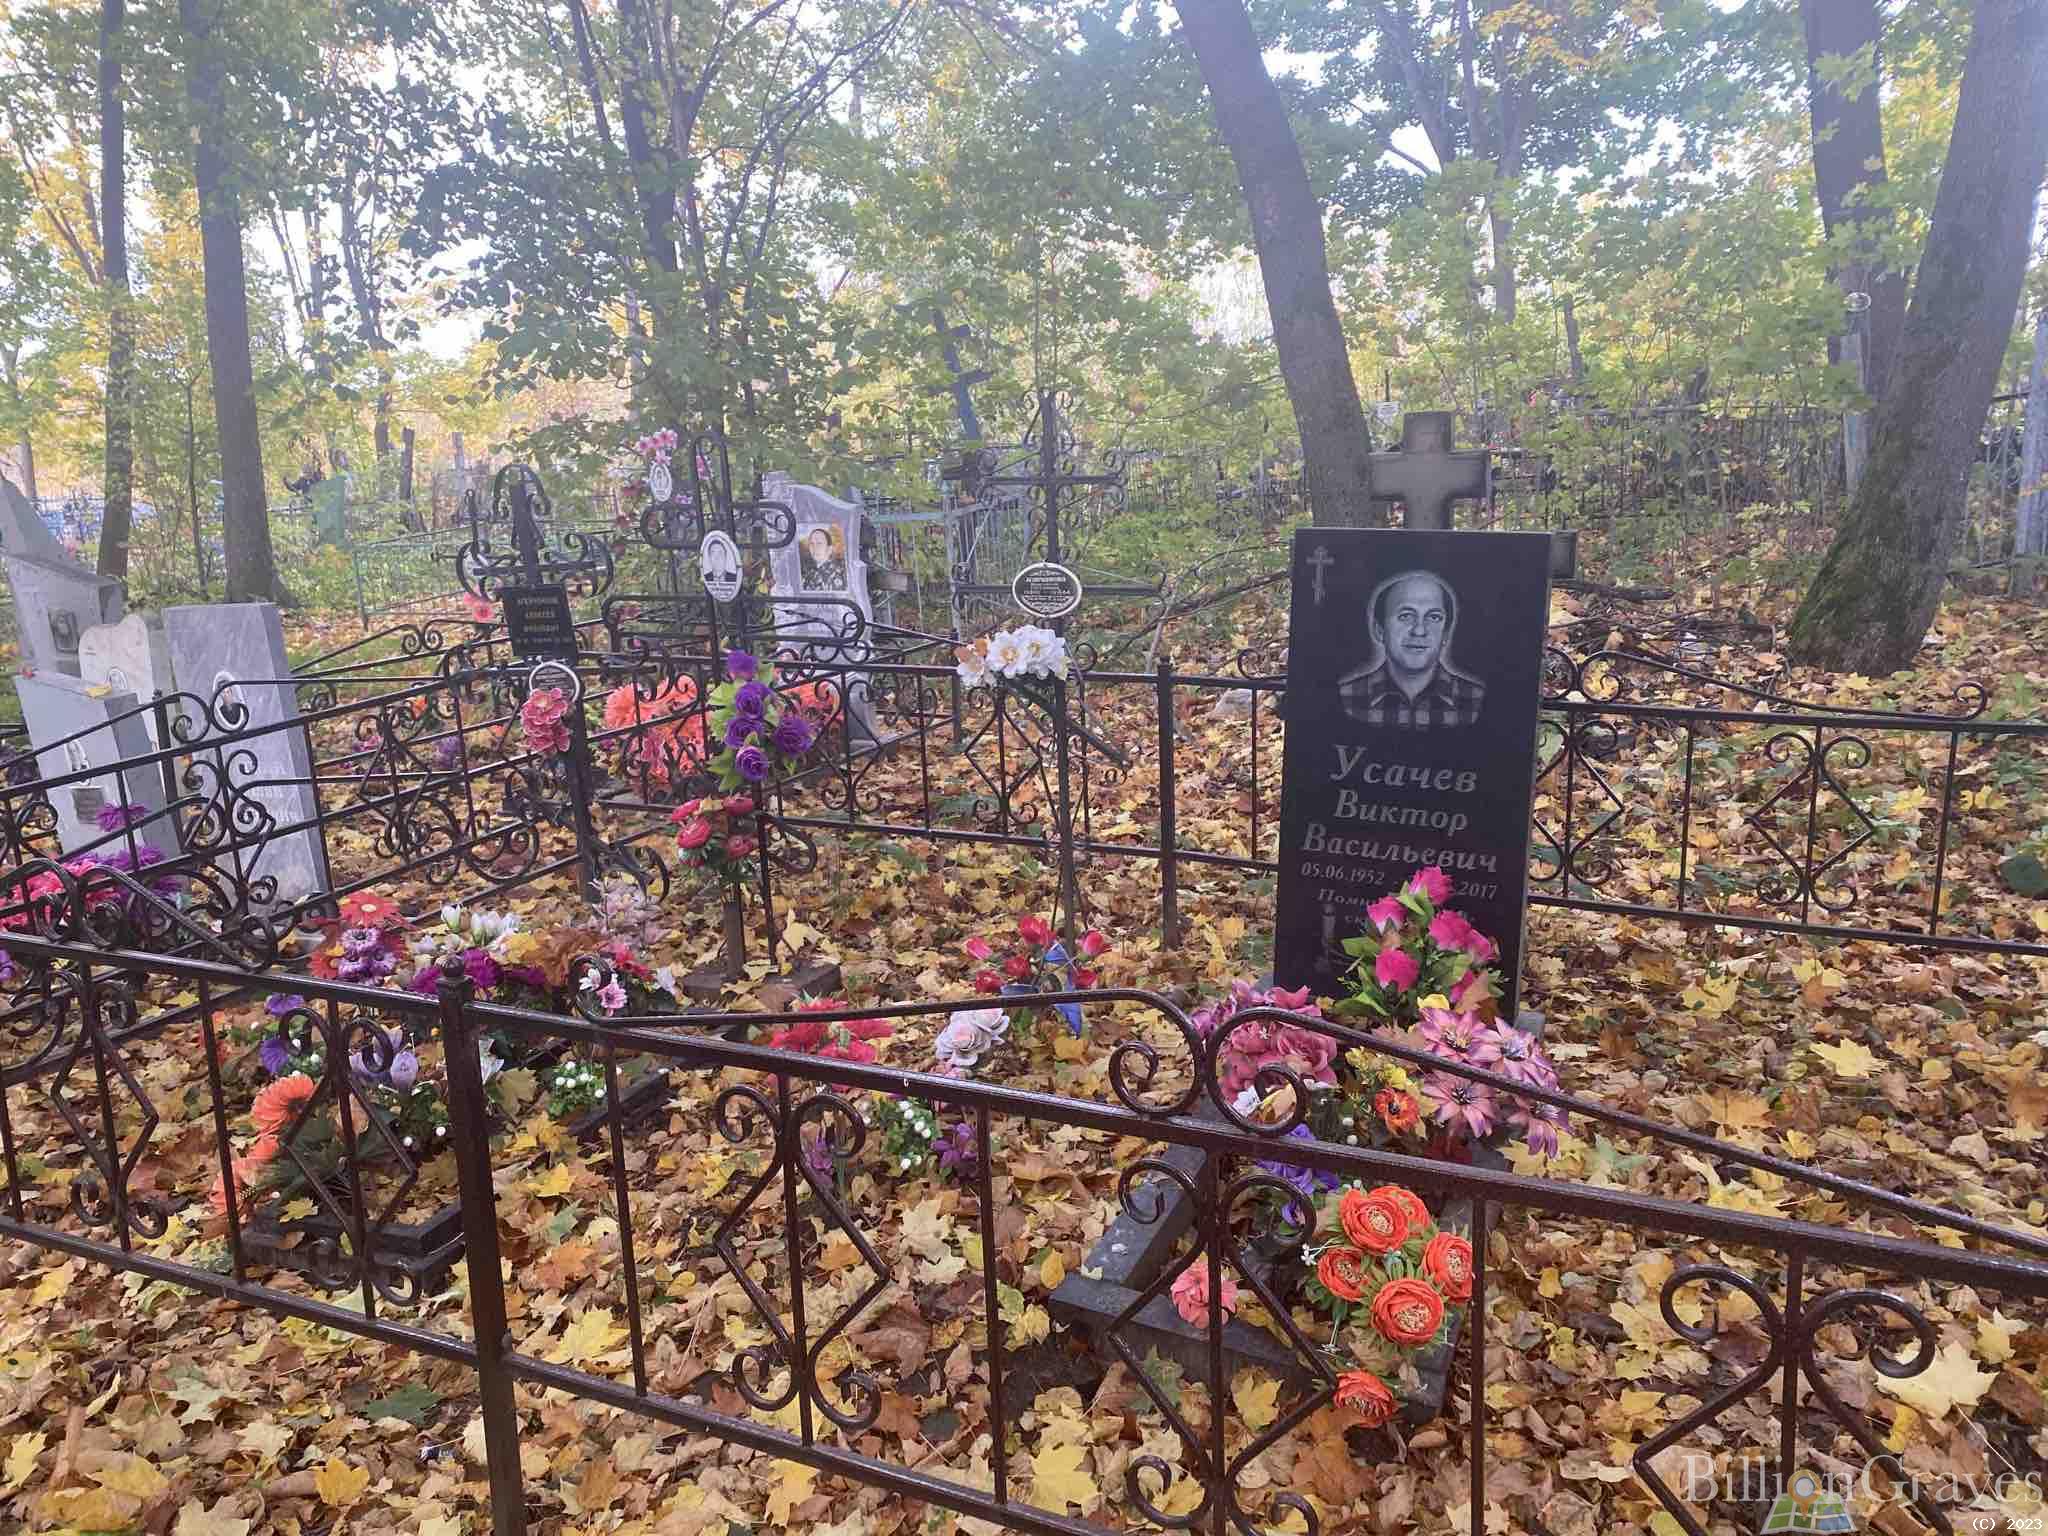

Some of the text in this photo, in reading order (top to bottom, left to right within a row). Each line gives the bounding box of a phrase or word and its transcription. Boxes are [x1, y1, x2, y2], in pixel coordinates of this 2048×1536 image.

[1330, 744, 1478, 793] Усачев
[1333, 788, 1468, 837] Виктор
[1303, 822, 1497, 873] Васильевич
[1301, 861, 1385, 885] 05.06.1952
